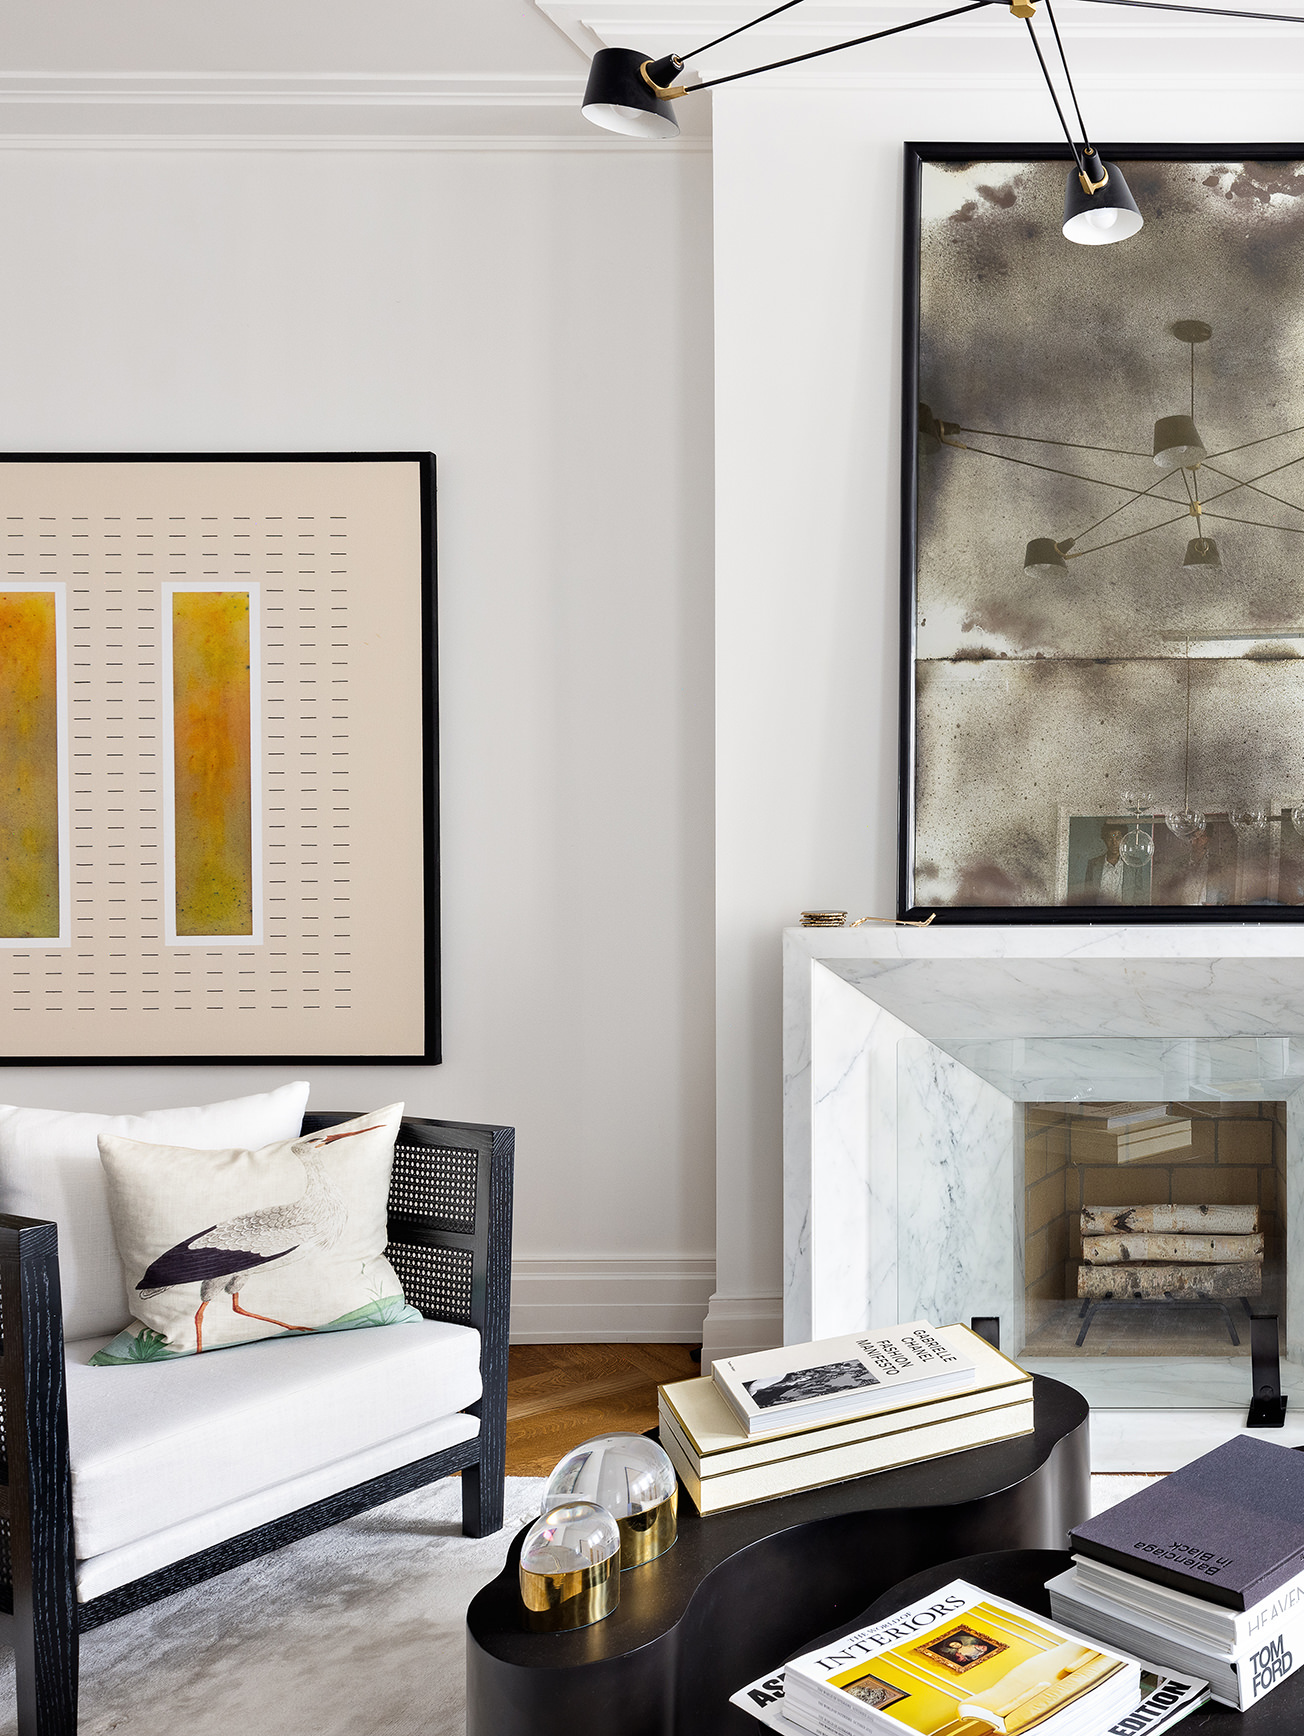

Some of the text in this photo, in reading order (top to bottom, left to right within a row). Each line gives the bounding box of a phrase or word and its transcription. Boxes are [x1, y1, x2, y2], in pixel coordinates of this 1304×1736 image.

[856, 1339, 900, 1376] MANIFESTO
[877, 1339, 914, 1369] FASHION
[901, 1336, 935, 1363] CHANEL
[913, 1329, 957, 1363] GABRIELLE
[1133, 1541, 1221, 1576] Balenciaga
[1172, 1541, 1233, 1571] in Black
[813, 1595, 966, 1672] INTERIORS
[848, 1611, 912, 1643] THE WORLD OF
[1249, 1634, 1284, 1676] TOM
[1252, 1650, 1294, 1698] FORD
[1108, 1679, 1192, 1736] EDITION
